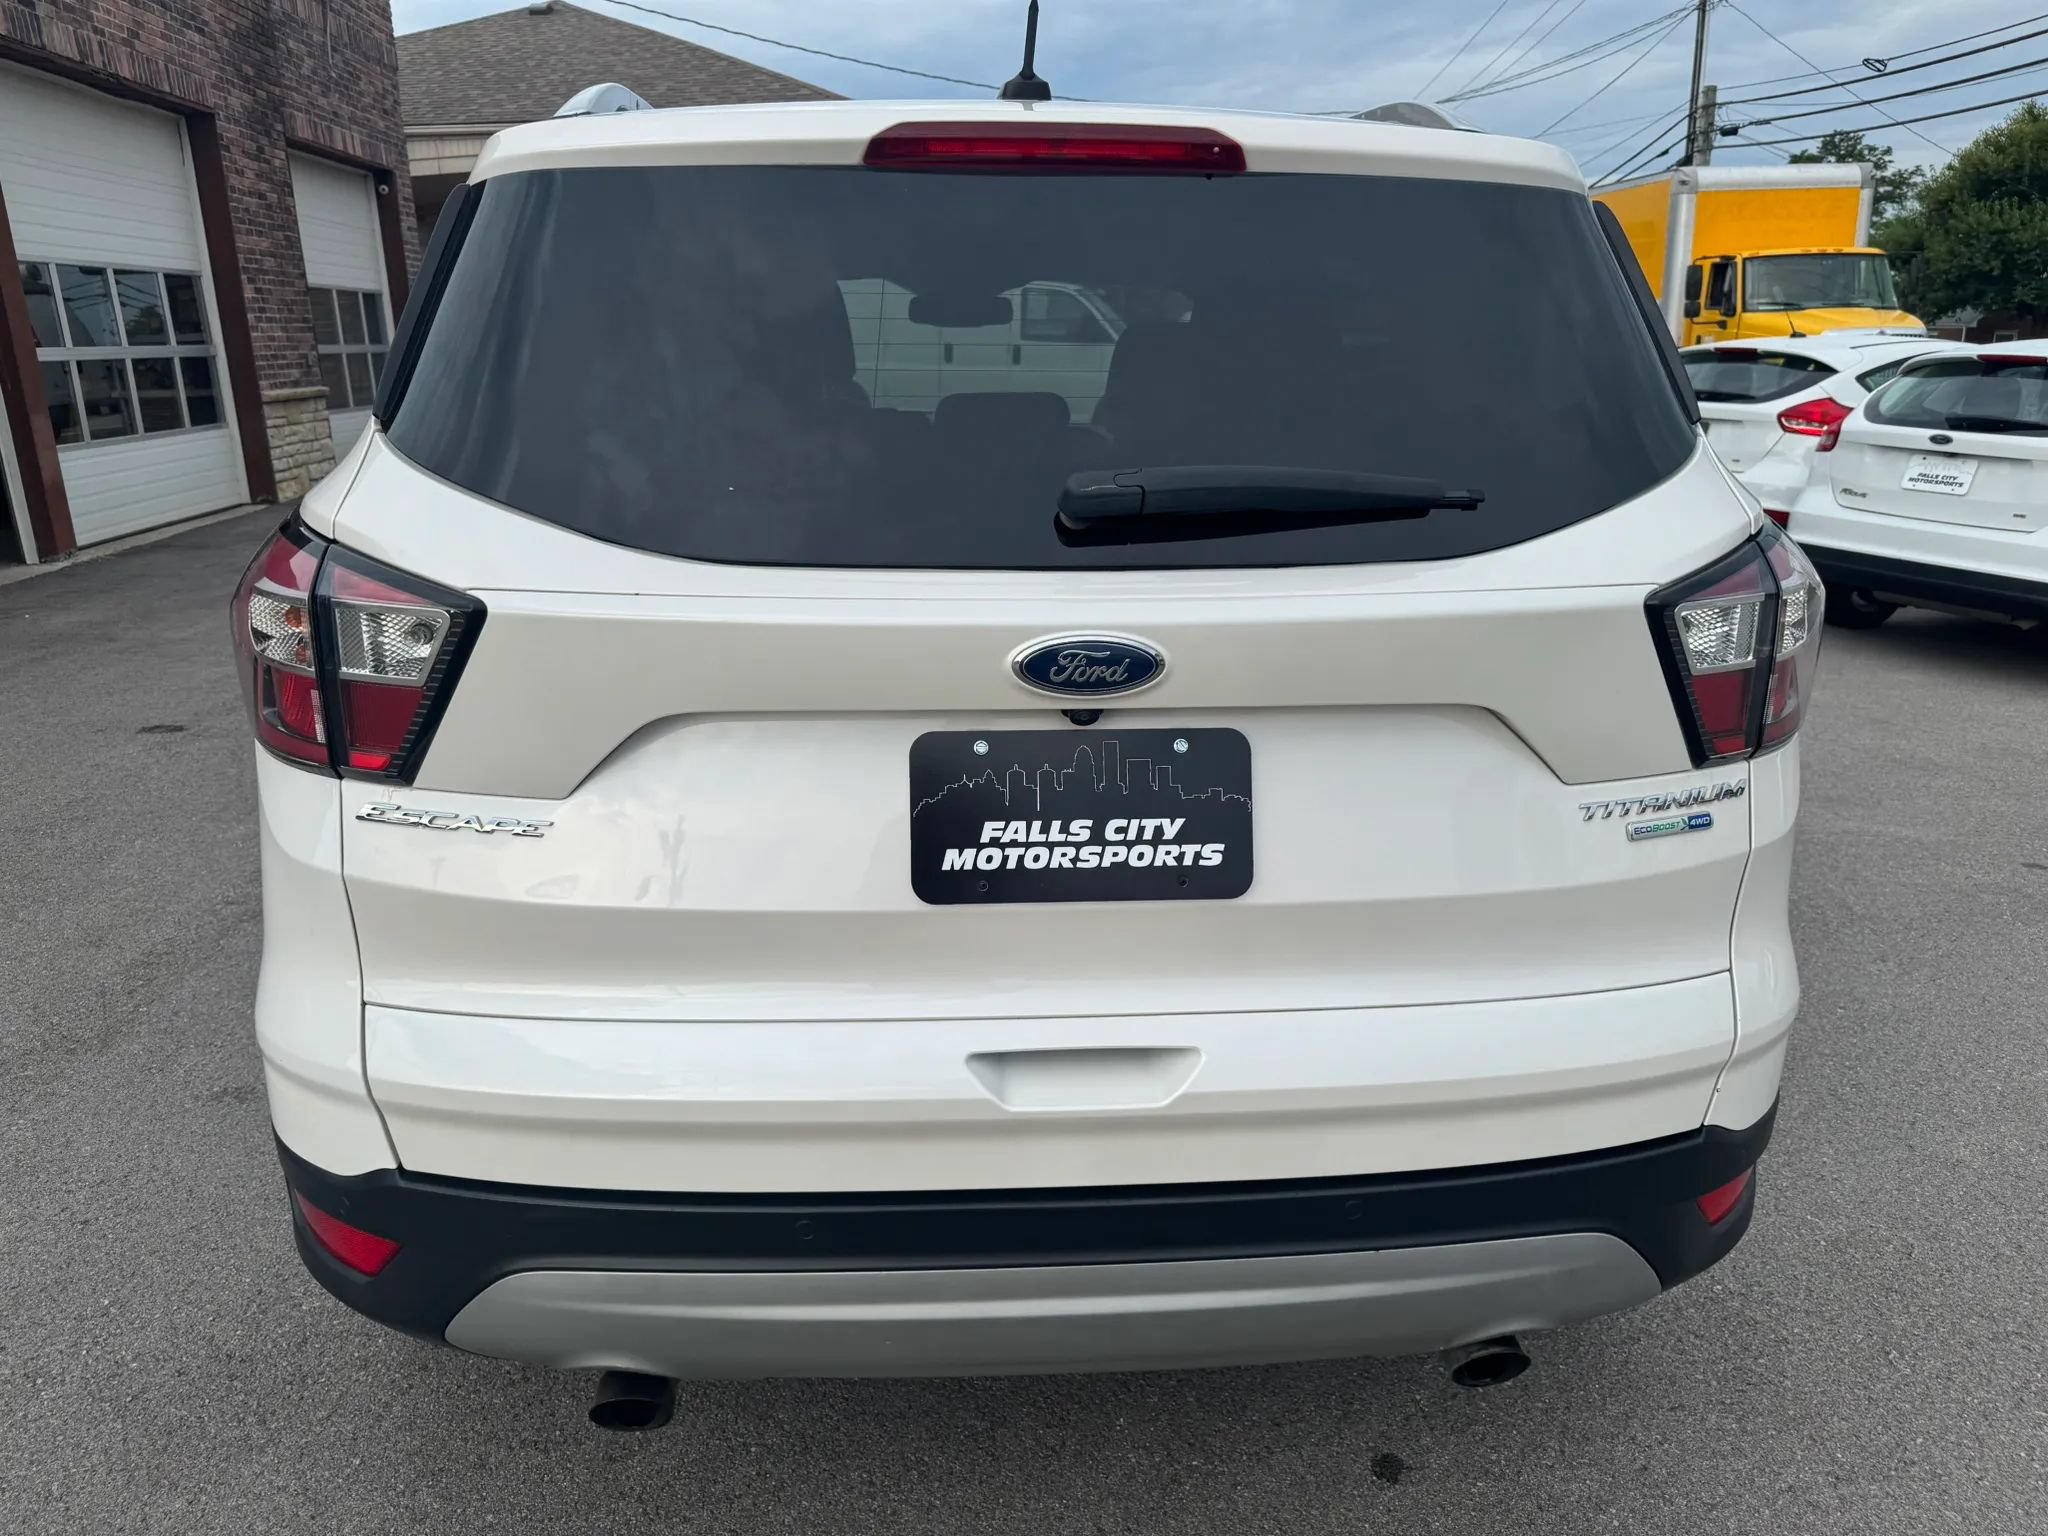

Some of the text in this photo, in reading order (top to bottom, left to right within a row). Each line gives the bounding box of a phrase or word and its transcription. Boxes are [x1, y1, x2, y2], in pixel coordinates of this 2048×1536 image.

[1908, 477, 1964, 488] MOTORSPORTS
[1917, 472, 1940, 480] FALLS
[1050, 649, 1131, 683] Ford
[1579, 778, 1747, 821] TITANIUM
[355, 802, 554, 838] ESCAPE
[980, 818, 1186, 843] FALLS CITY
[1689, 816, 1711, 826] 4WD
[941, 844, 1225, 871] MOTORSPORTS
